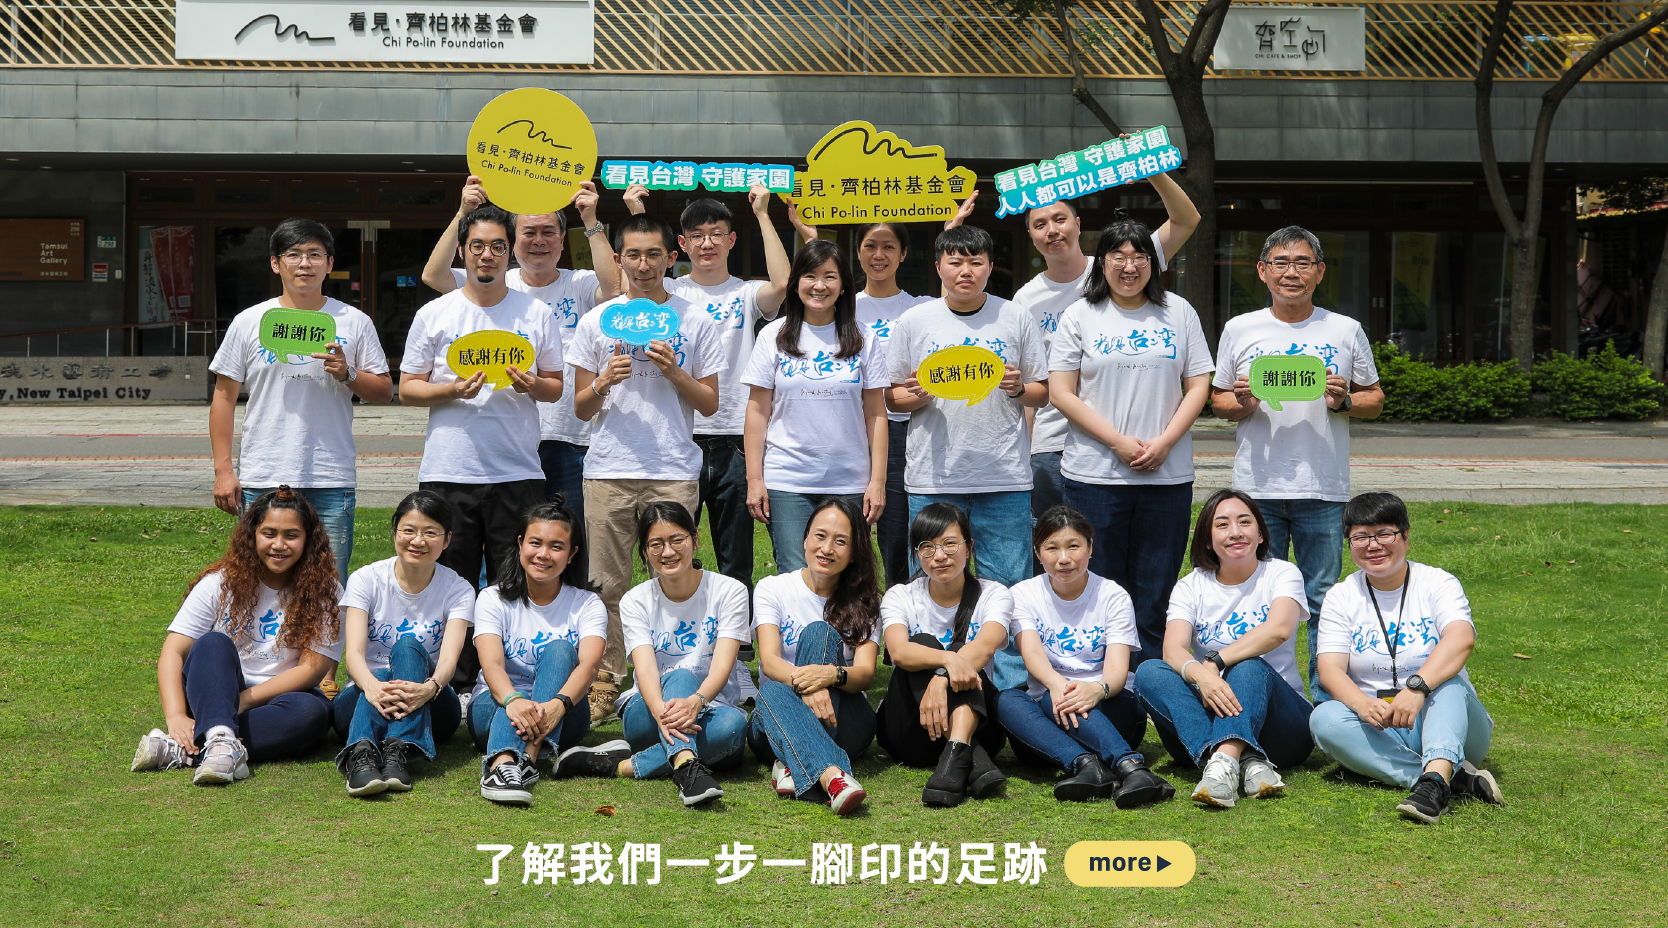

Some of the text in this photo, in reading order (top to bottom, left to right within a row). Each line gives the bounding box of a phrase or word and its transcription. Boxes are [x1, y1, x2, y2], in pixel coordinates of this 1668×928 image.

[348, 12, 538, 33] 看見·齊柏林基金會
[382, 36, 504, 49] Chi Po-lin Foundation
[997, 127, 1168, 193] 看見台灣 守護家園
[481, 160, 572, 187] Chi Po-lin Foundation
[605, 164, 791, 189] 看見台灣 守護家園
[997, 148, 1180, 216] 人人都可以是齊柏林
[802, 203, 952, 219] Chi Po-lin Foundation
[40, 257, 68, 265] Gallery
[272, 322, 326, 343] 謝謝你
[458, 347, 525, 366] 感謝有你
[929, 361, 995, 385] 感謝有你
[1262, 370, 1316, 387] 謝謝你
[56, 387, 108, 401] Taipei
[115, 387, 151, 400] City
